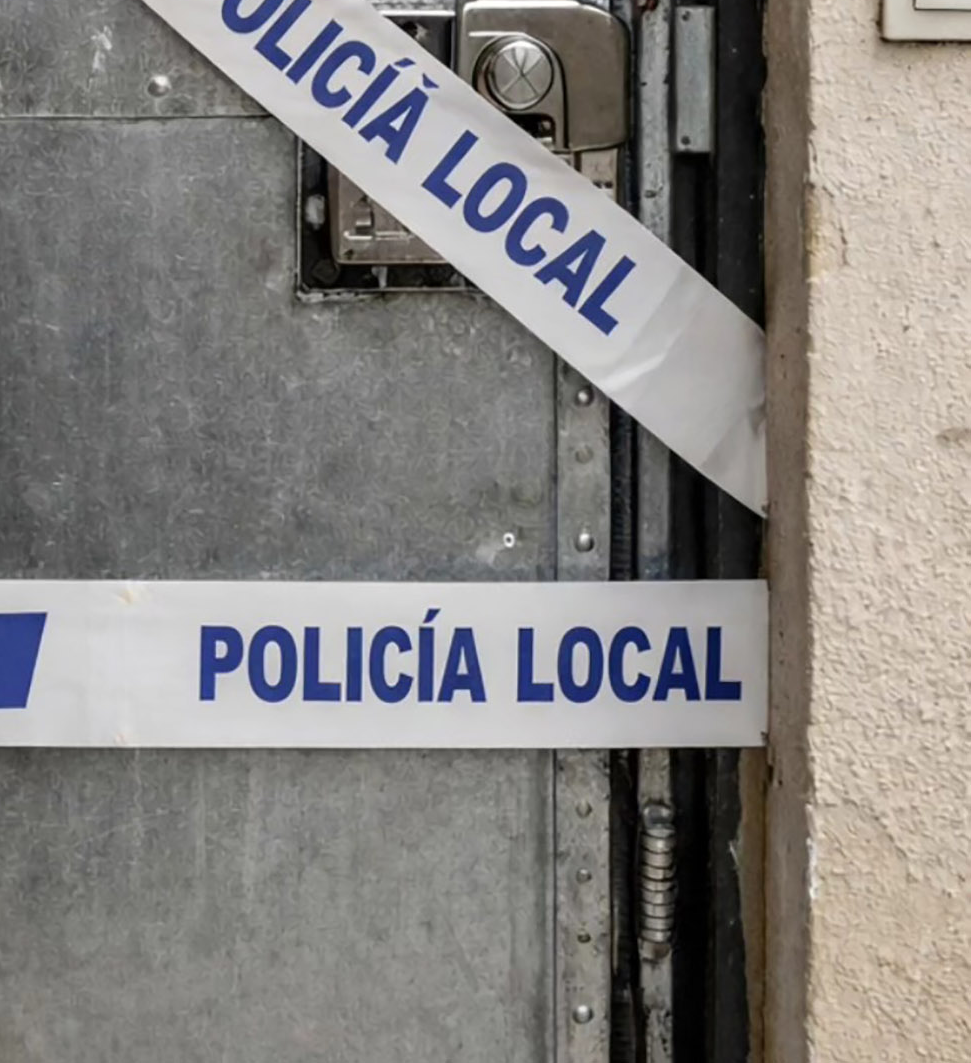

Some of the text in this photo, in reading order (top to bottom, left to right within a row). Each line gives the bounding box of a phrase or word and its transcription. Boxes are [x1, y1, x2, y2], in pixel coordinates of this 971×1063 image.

[421, 130, 637, 335] LOCAL
[200, 608, 742, 704] POLICÍA LOCAL
